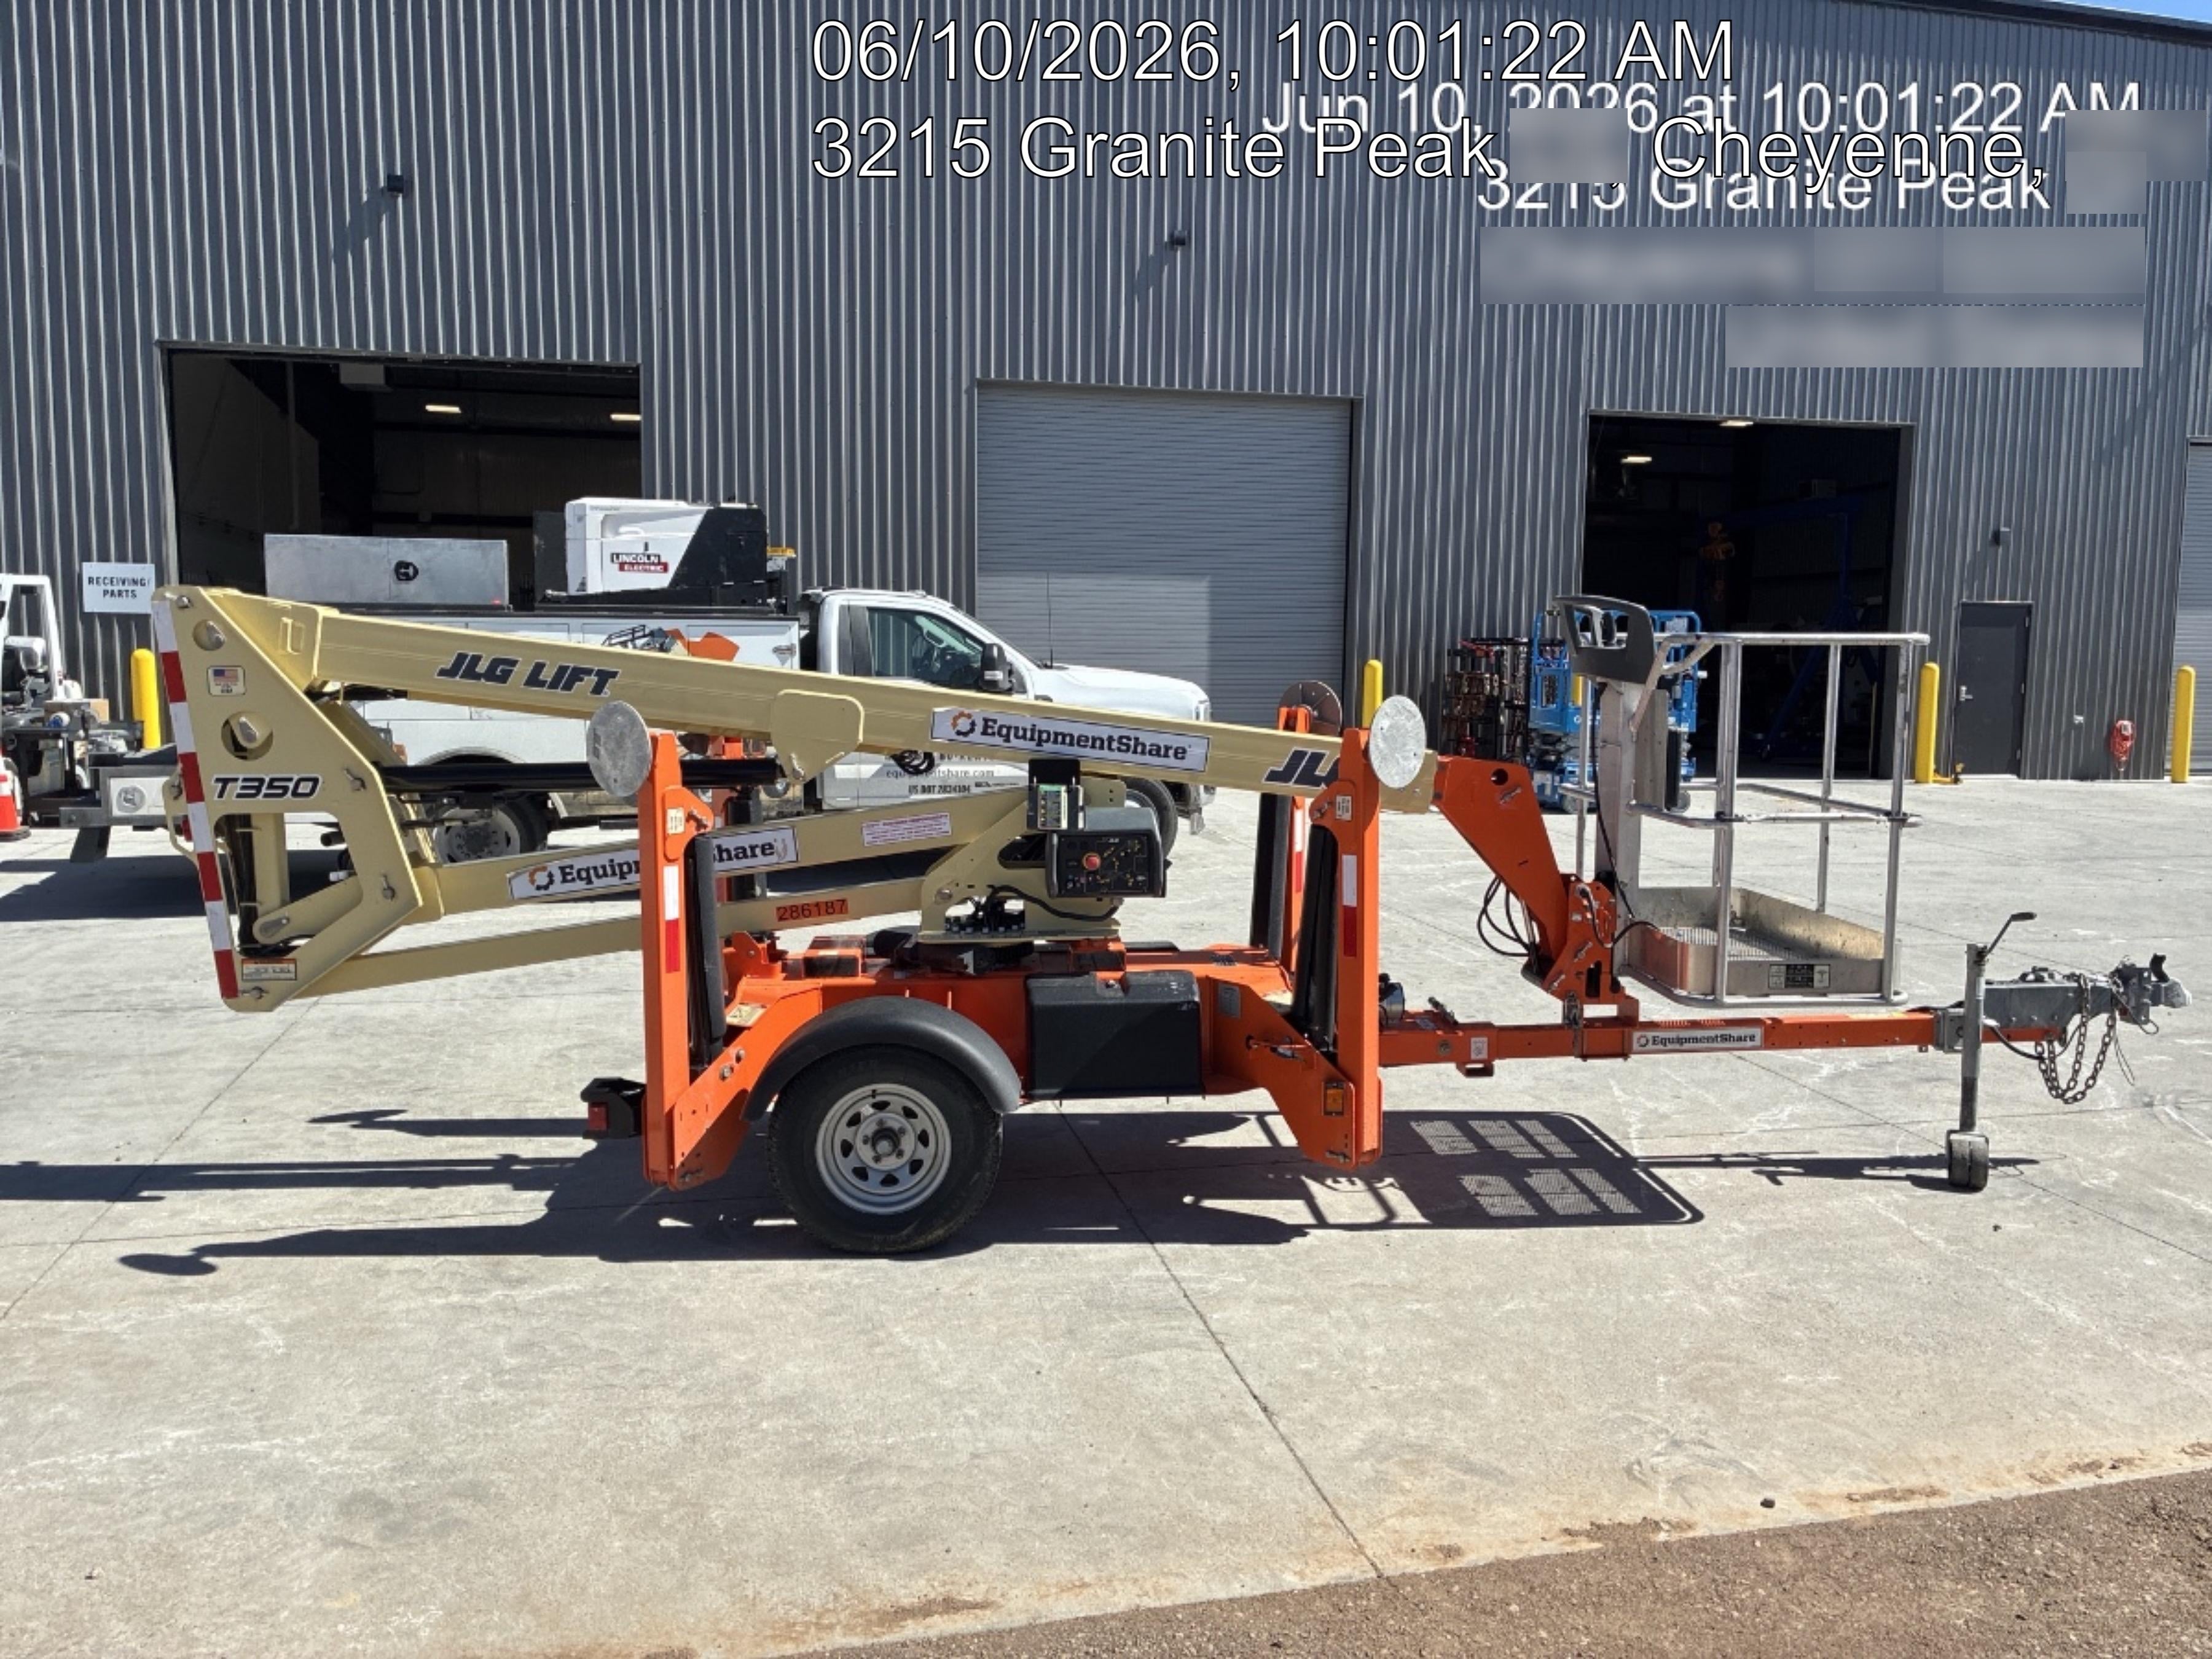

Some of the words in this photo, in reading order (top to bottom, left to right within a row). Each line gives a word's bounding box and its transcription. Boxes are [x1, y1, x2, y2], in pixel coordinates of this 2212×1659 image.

[613, 554, 659, 563] LINCOLN
[103, 589, 137, 599] PARTS
[436, 651, 522, 685] JLG
[522, 661, 621, 696] LIFT
[979, 717, 1188, 761] EquipmentShare
[213, 775, 321, 799] T350
[775, 898, 846, 922] 286187
[1651, 1033, 1756, 1047] EquipmentShare
